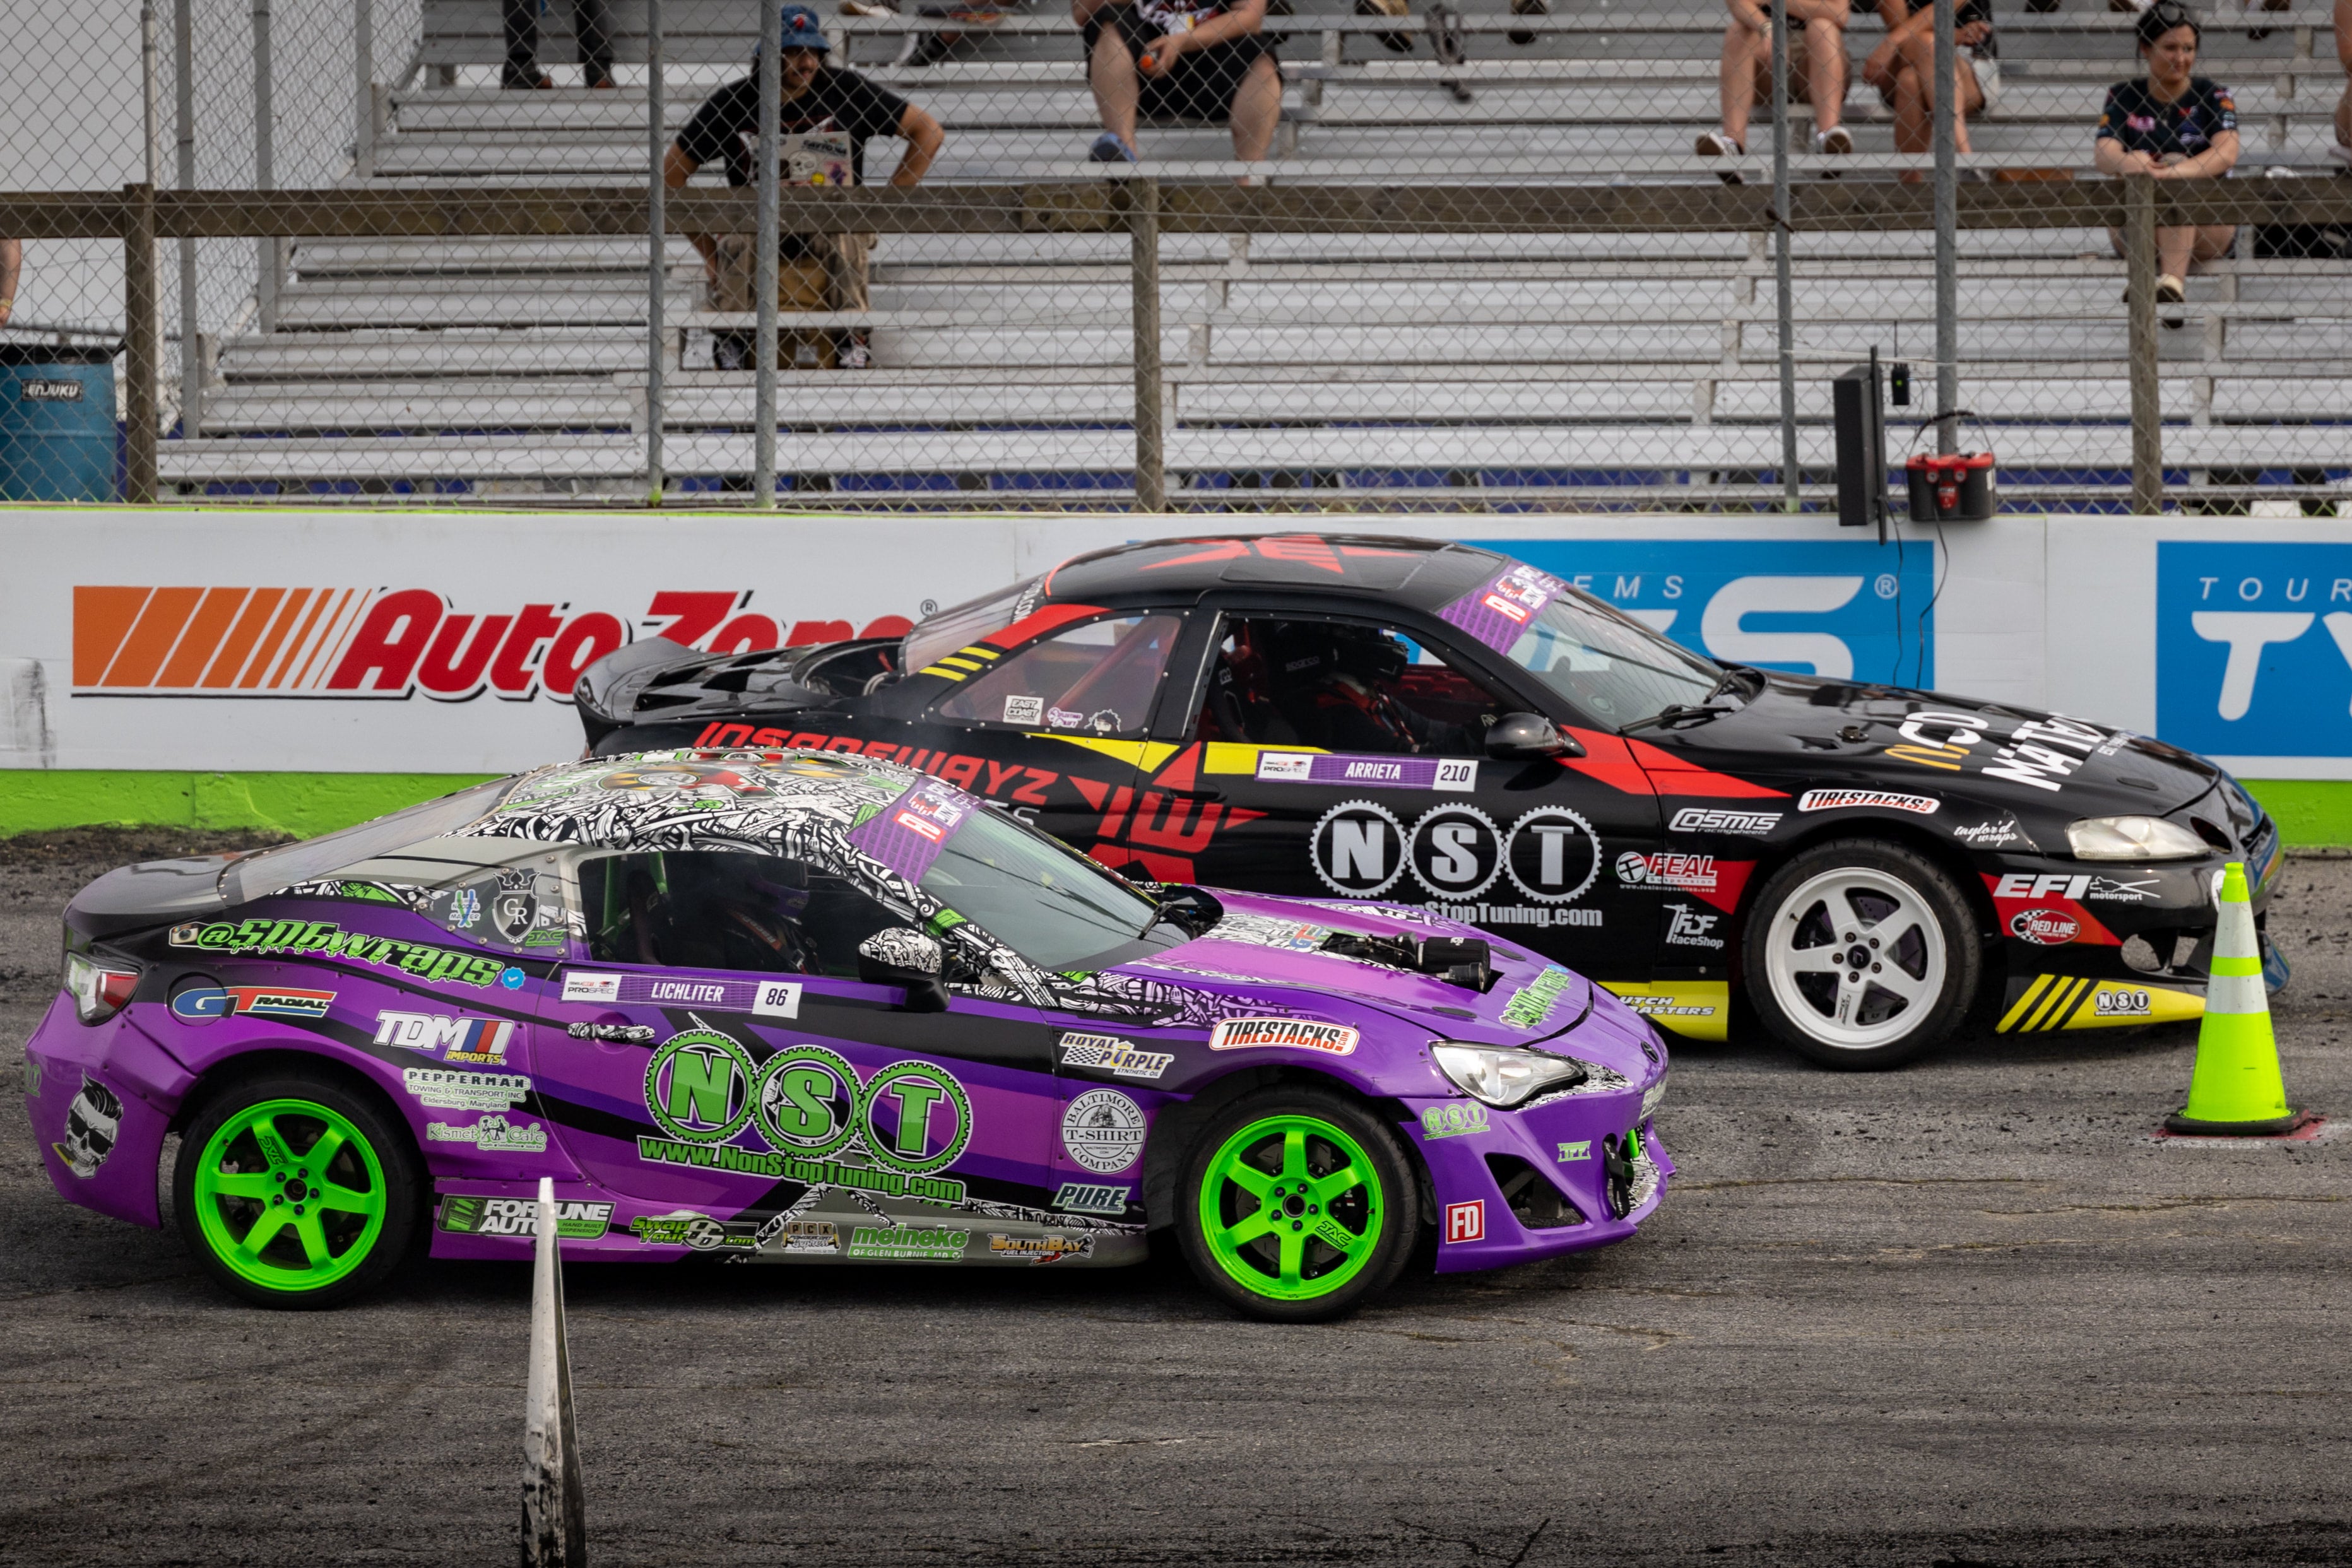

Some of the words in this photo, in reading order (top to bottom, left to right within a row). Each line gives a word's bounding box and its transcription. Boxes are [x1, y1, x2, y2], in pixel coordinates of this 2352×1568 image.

[28, 384, 78, 398] ENJUKU
[2199, 577, 2352, 601] TOUR
[1006, 708, 1040, 717] COAST
[1012, 699, 1038, 708] EAST
[1345, 762, 1402, 780] ARRIETA
[1440, 765, 1470, 782] 210
[1977, 830, 2019, 847] wraps
[1646, 852, 1718, 878] FEAL
[1993, 873, 2092, 899] EFI
[2089, 892, 2142, 902] motorsport
[503, 898, 528, 925] GR
[1382, 900, 1603, 927] StopTuning.com
[2030, 920, 2051, 933] RED
[2052, 921, 2077, 934] LINE
[1670, 934, 1725, 950] RaceShop
[567, 986, 615, 994] PROSPEC
[651, 982, 725, 1002] LICHLITER
[765, 987, 789, 1006] 86
[256, 997, 328, 1011] RADIAL
[2098, 993, 2146, 1007] NST
[1063, 1034, 1116, 1049] ROYAL
[1097, 1049, 1167, 1071] PURPLE
[408, 1071, 524, 1088] PEPPERMAN
[1116, 1068, 1147, 1076] SYNTHETIC
[409, 1084, 442, 1093] TOWING
[469, 1100, 507, 1109] Maryland
[667, 1051, 943, 1155] NST
[1067, 1093, 1140, 1125] BALTIMORE
[1426, 1105, 1481, 1129] NST
[429, 1124, 478, 1137] Kismet
[509, 1126, 546, 1143] Cafe
[1066, 1129, 1142, 1141] T-SHIRT
[1072, 1147, 1136, 1170] COMPANY
[640, 1138, 963, 1201] www.NonStopTuning.com
[1055, 1185, 1126, 1208] PURE
[483, 1200, 612, 1221] FORUNE
[478, 1216, 538, 1235] AUT
[632, 1217, 690, 1232] Swap
[792, 1224, 830, 1234] PCX
[1451, 1205, 1480, 1240] FD
[853, 1223, 969, 1249] meineke
